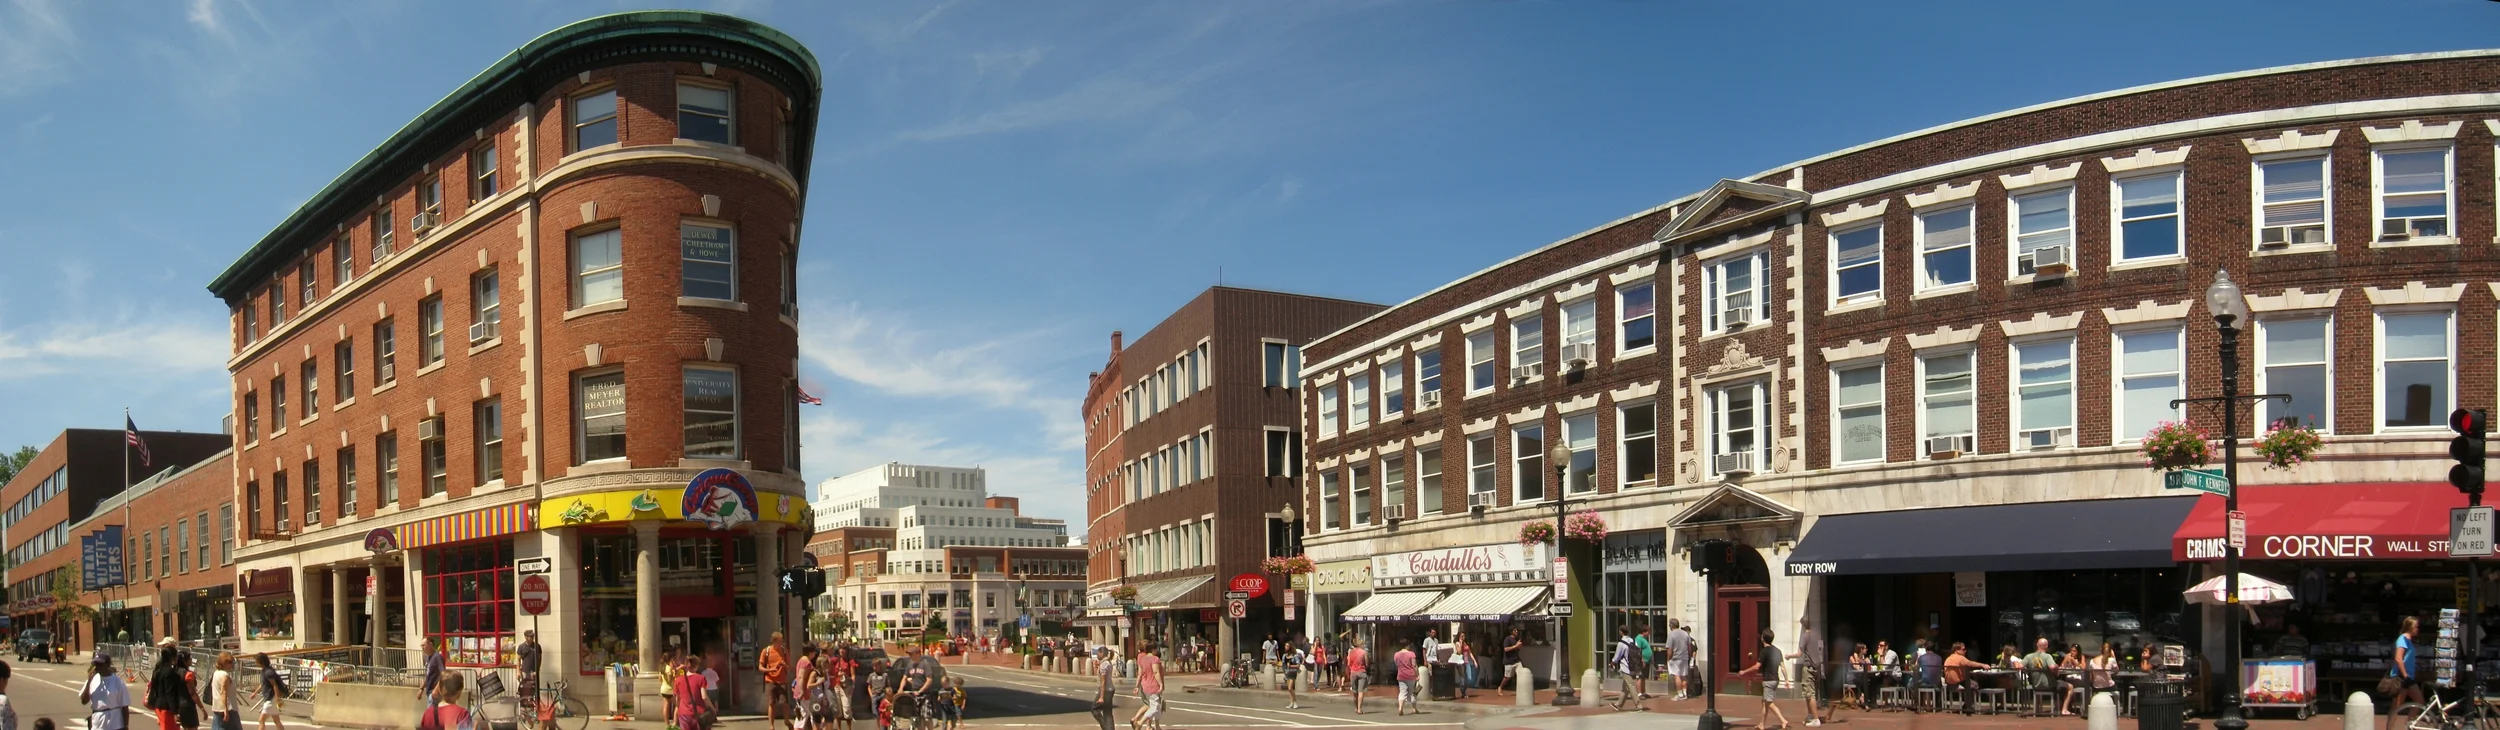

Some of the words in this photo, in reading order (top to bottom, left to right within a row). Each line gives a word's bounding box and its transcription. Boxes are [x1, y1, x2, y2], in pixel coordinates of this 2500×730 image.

[699, 249, 718, 257] HOWE
[592, 381, 616, 390] FRED
[590, 389, 620, 400] MEYER
[585, 398, 624, 410] REALTOR
[2184, 473, 2198, 486] JOHN
[2199, 476, 2204, 488] F.
[2206, 478, 2227, 493] KENNEDY
[2470, 513, 2486, 521] LEFT
[2463, 527, 2481, 535] TURN
[2187, 538, 2244, 558] CRIMS
[2264, 536, 2373, 557] CORNER
[2387, 541, 2422, 552] WALL
[2428, 541, 2450, 552] STR
[2470, 541, 2484, 549] RED
[1605, 545, 1641, 559] BLACK
[84, 544, 95, 588] URBAN
[109, 546, 121, 582] TERS
[1408, 547, 1492, 574] Cardullo's
[1790, 564, 1813, 573] TORY
[1815, 562, 1836, 573] ROW
[1318, 568, 1366, 585] ORIGINS
[1240, 579, 1262, 588] COOP
